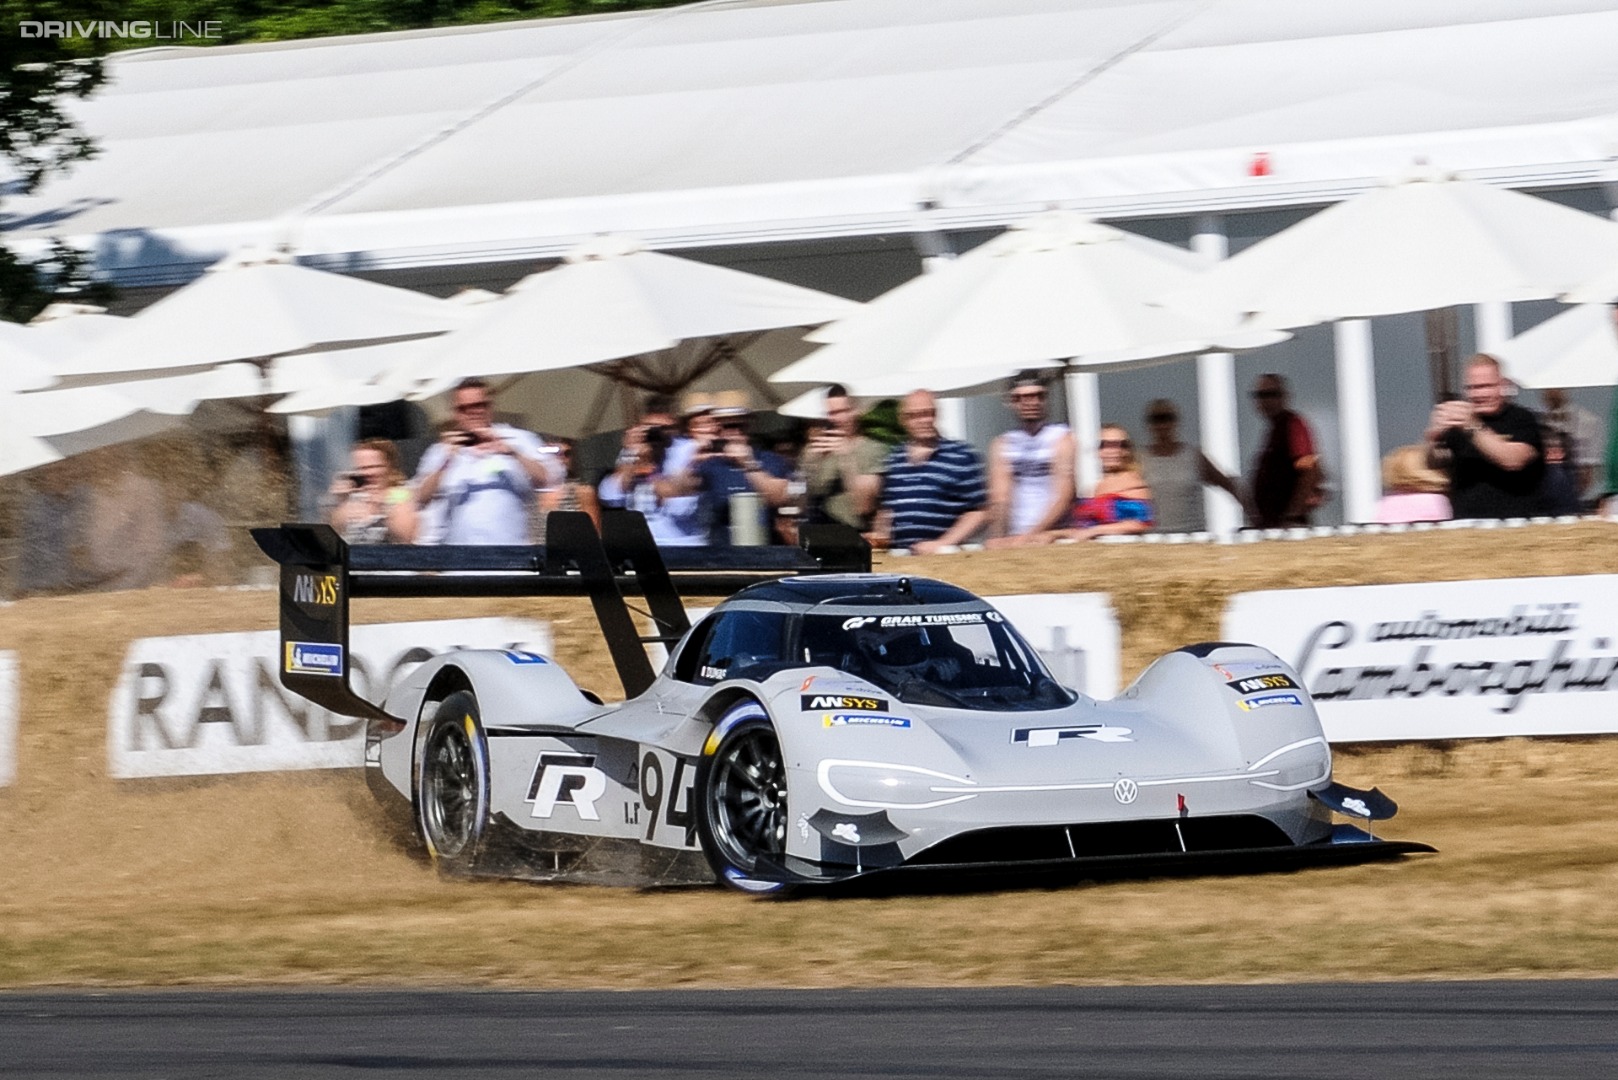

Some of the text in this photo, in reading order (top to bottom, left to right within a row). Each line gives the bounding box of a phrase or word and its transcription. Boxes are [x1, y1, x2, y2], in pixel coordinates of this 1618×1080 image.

[293, 574, 337, 605] ANSYS
[880, 615, 922, 625] GRAN
[925, 613, 983, 623] TURISMO
[1239, 674, 1290, 692] ANSYS
[810, 695, 879, 709] ANSYS
[524, 751, 607, 821] R
[641, 751, 697, 847] 94
